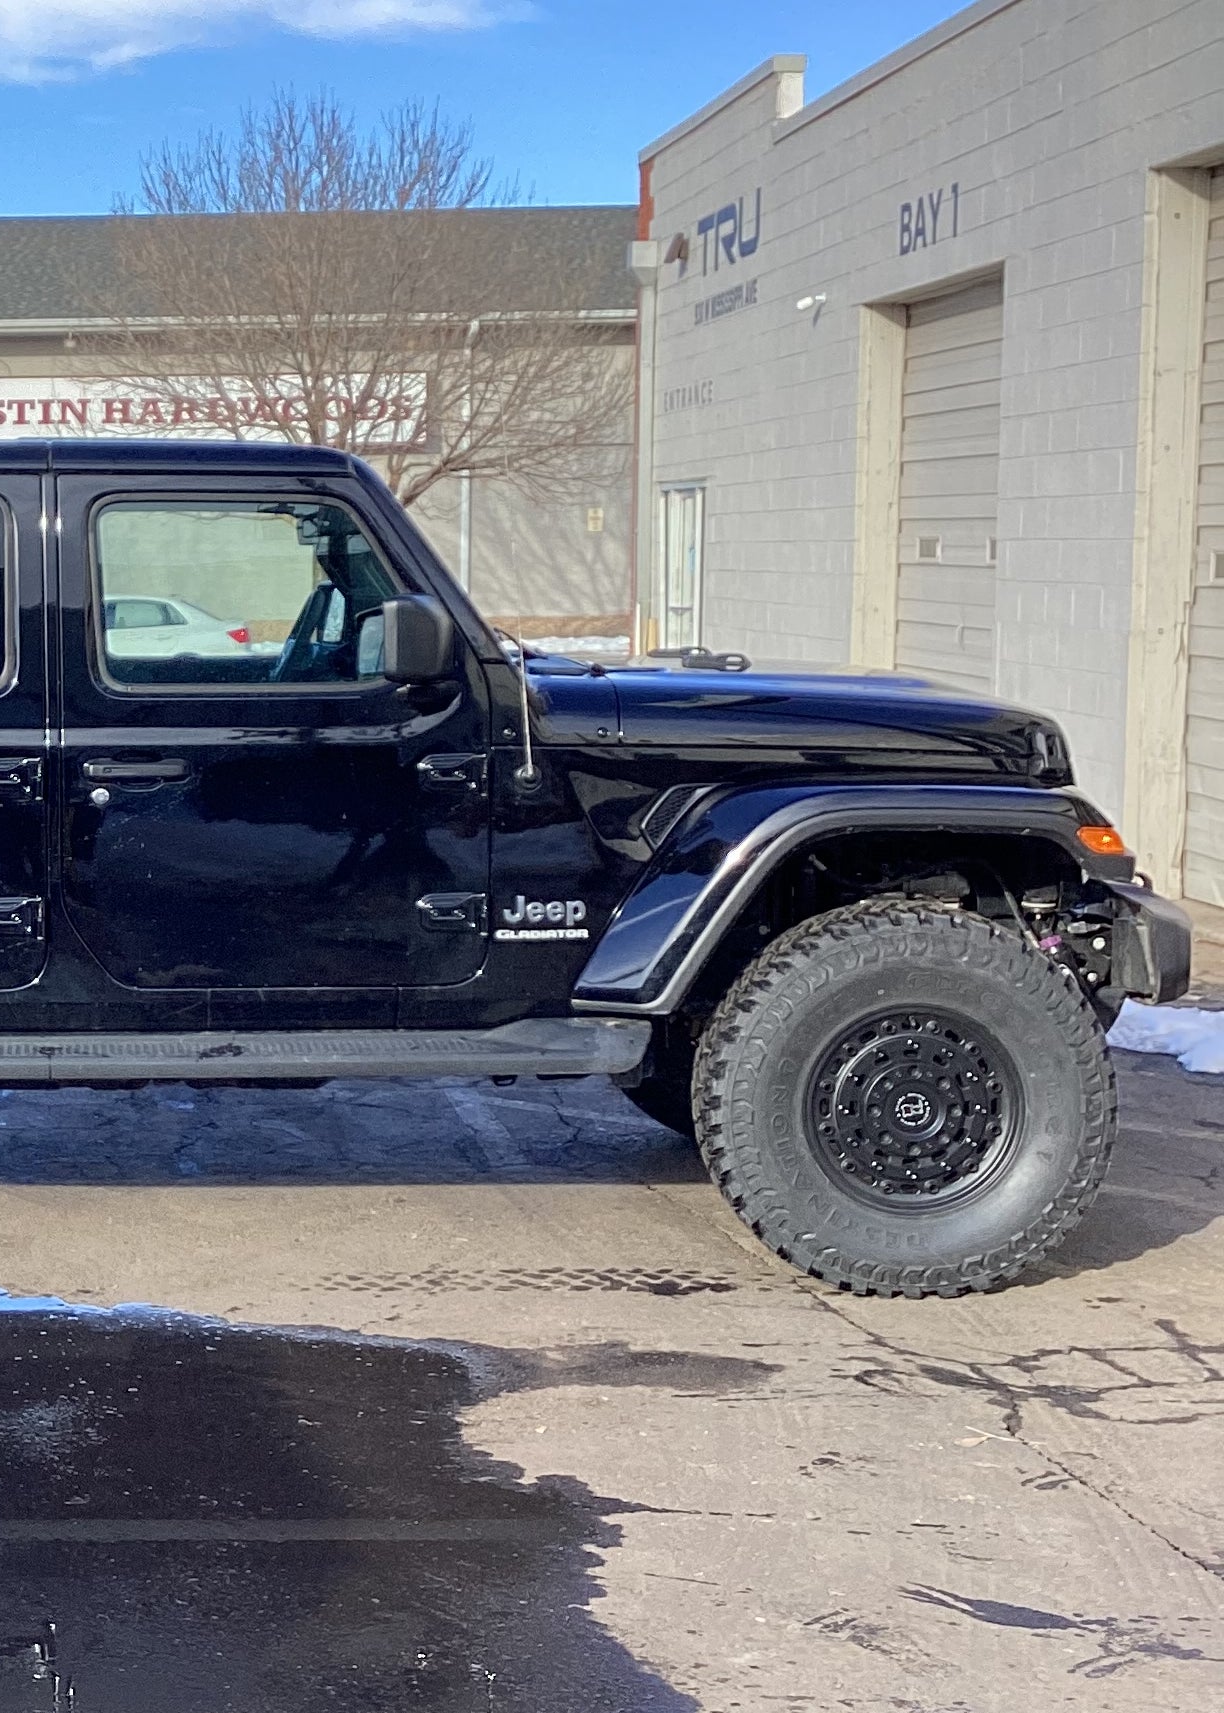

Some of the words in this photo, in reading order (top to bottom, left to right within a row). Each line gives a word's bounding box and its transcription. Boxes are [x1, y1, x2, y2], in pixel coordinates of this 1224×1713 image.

[697, 187, 761, 276] TRU
[899, 188, 944, 256] BAY
[951, 182, 960, 238] 1
[663, 379, 713, 413] ENTRANCE
[503, 895, 587, 926] Jeep
[495, 928, 590, 940] GLADIATOR
